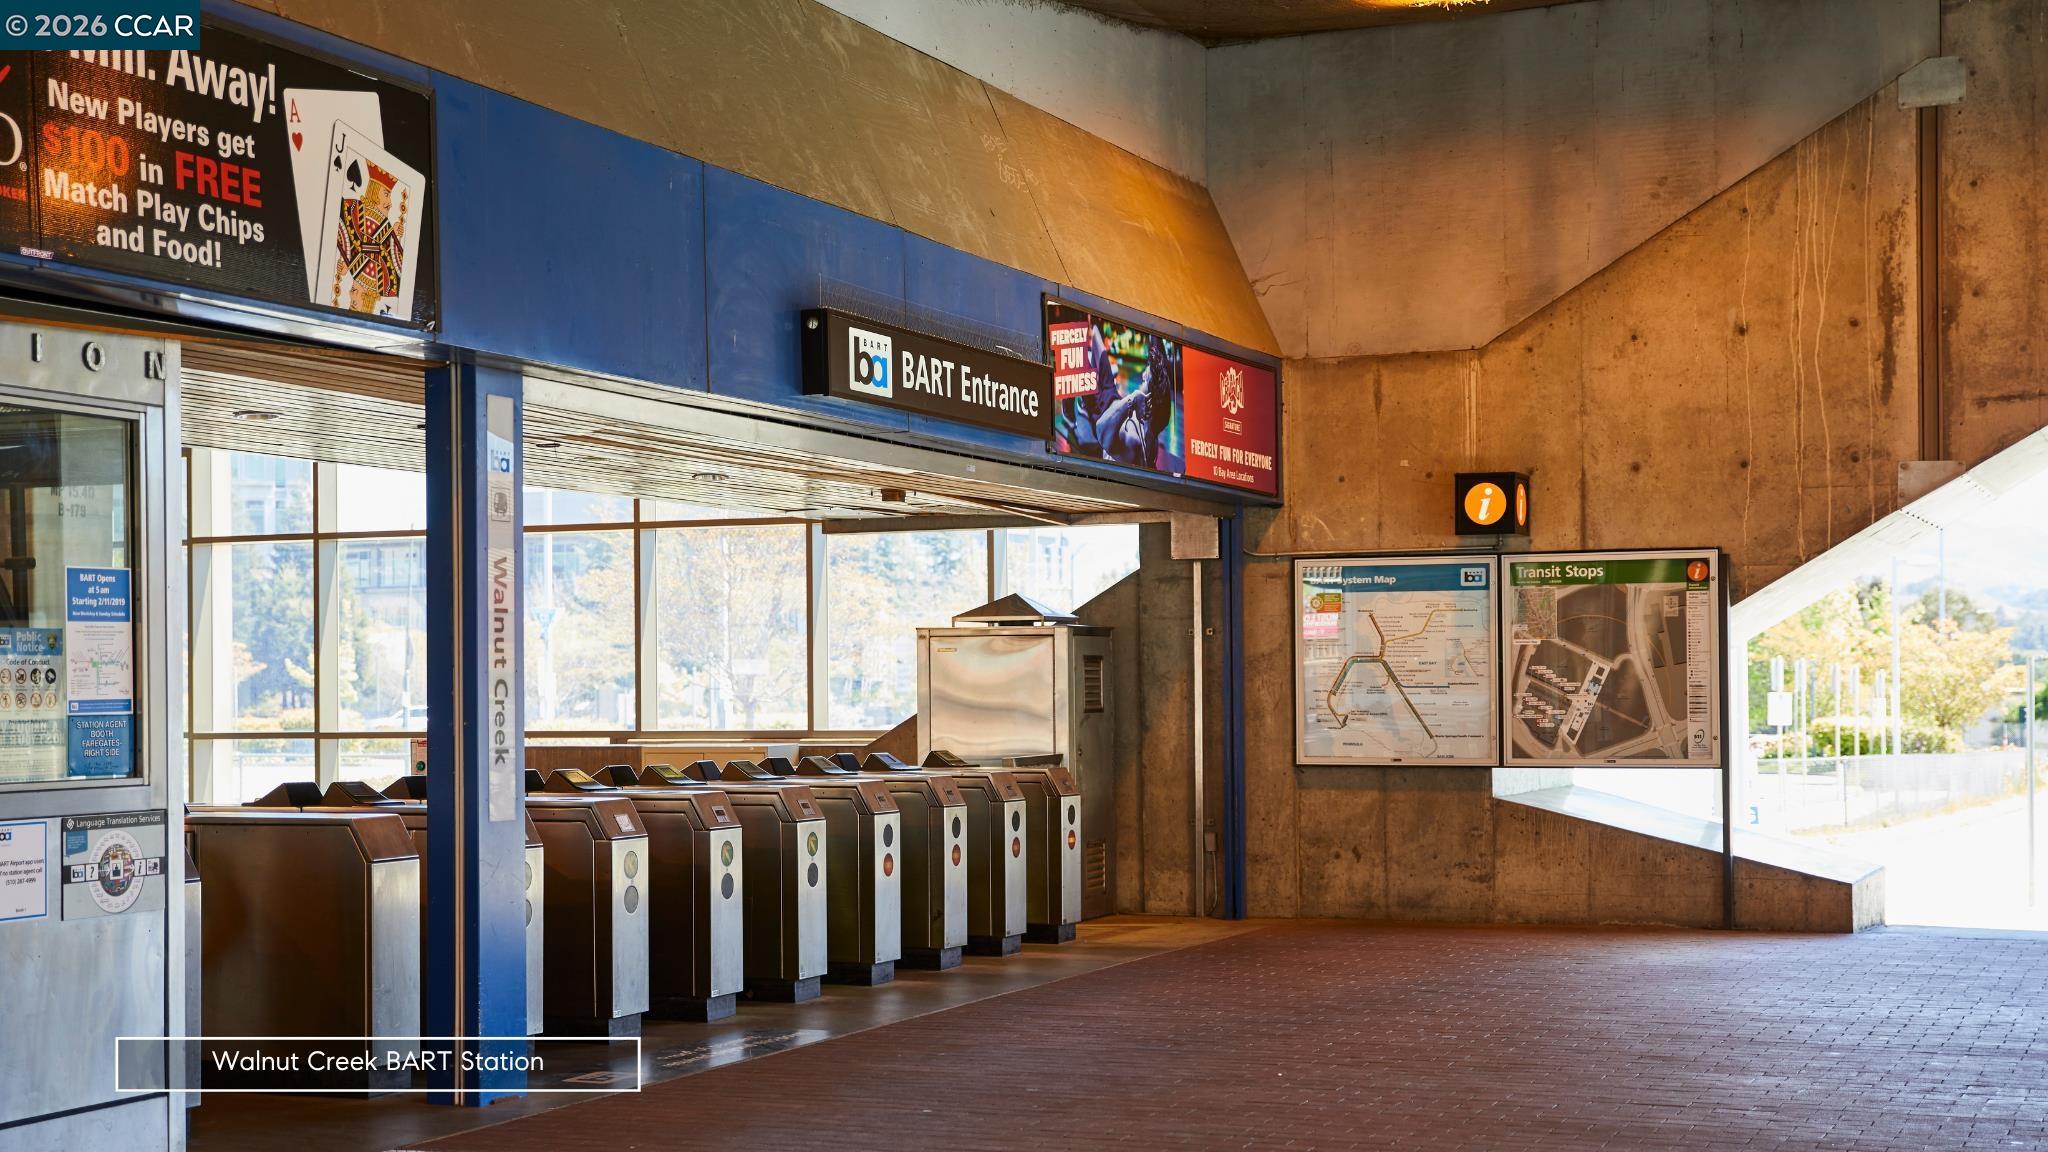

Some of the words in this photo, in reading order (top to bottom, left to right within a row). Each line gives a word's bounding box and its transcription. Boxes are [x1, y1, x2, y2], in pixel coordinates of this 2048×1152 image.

[166, 50, 276, 123] Away!
[48, 78, 108, 120] New
[117, 97, 210, 147] Players
[217, 131, 256, 158] get
[42, 121, 131, 176] $100
[139, 153, 164, 185] in
[175, 150, 262, 208] FREE
[44, 169, 128, 213] Match
[137, 189, 190, 232] Play
[198, 204, 265, 244] Chips
[96, 224, 144, 253] and
[153, 228, 221, 267] Food!
[1051, 328, 1088, 346] FIERCELY
[863, 339, 888, 352] BART
[1060, 347, 1084, 370] FUN
[902, 350, 955, 398] BART
[961, 365, 1039, 417] Entrance
[1055, 372, 1097, 396] FITNESS
[1191, 439, 1218, 459] FIERCELY
[1219, 445, 1231, 461] FUN
[1232, 448, 1243, 465] FOR
[1245, 451, 1272, 470] EVERYONE
[1227, 469, 1236, 479] Area
[80, 574, 96, 582] BART
[97, 574, 116, 584] Opens
[1374, 575, 1396, 585] Map
[1515, 565, 1561, 578] Transit
[1565, 565, 1604, 580] Stops
[88, 586, 94, 594] at
[96, 586, 99, 594] 5
[72, 597, 97, 607] Starting
[493, 556, 508, 669] Walnut
[16, 631, 42, 641] Public
[16, 642, 43, 652] Notice
[76, 720, 105, 728] STATION
[106, 720, 127, 728] AGENT
[494, 679, 510, 765] Creek
[90, 730, 114, 738] BOOTH
[84, 749, 103, 757] RIGHT
[106, 748, 120, 756] SIDE
[76, 818, 105, 829] Language
[107, 816, 138, 825] Translation
[139, 814, 161, 822] Services
